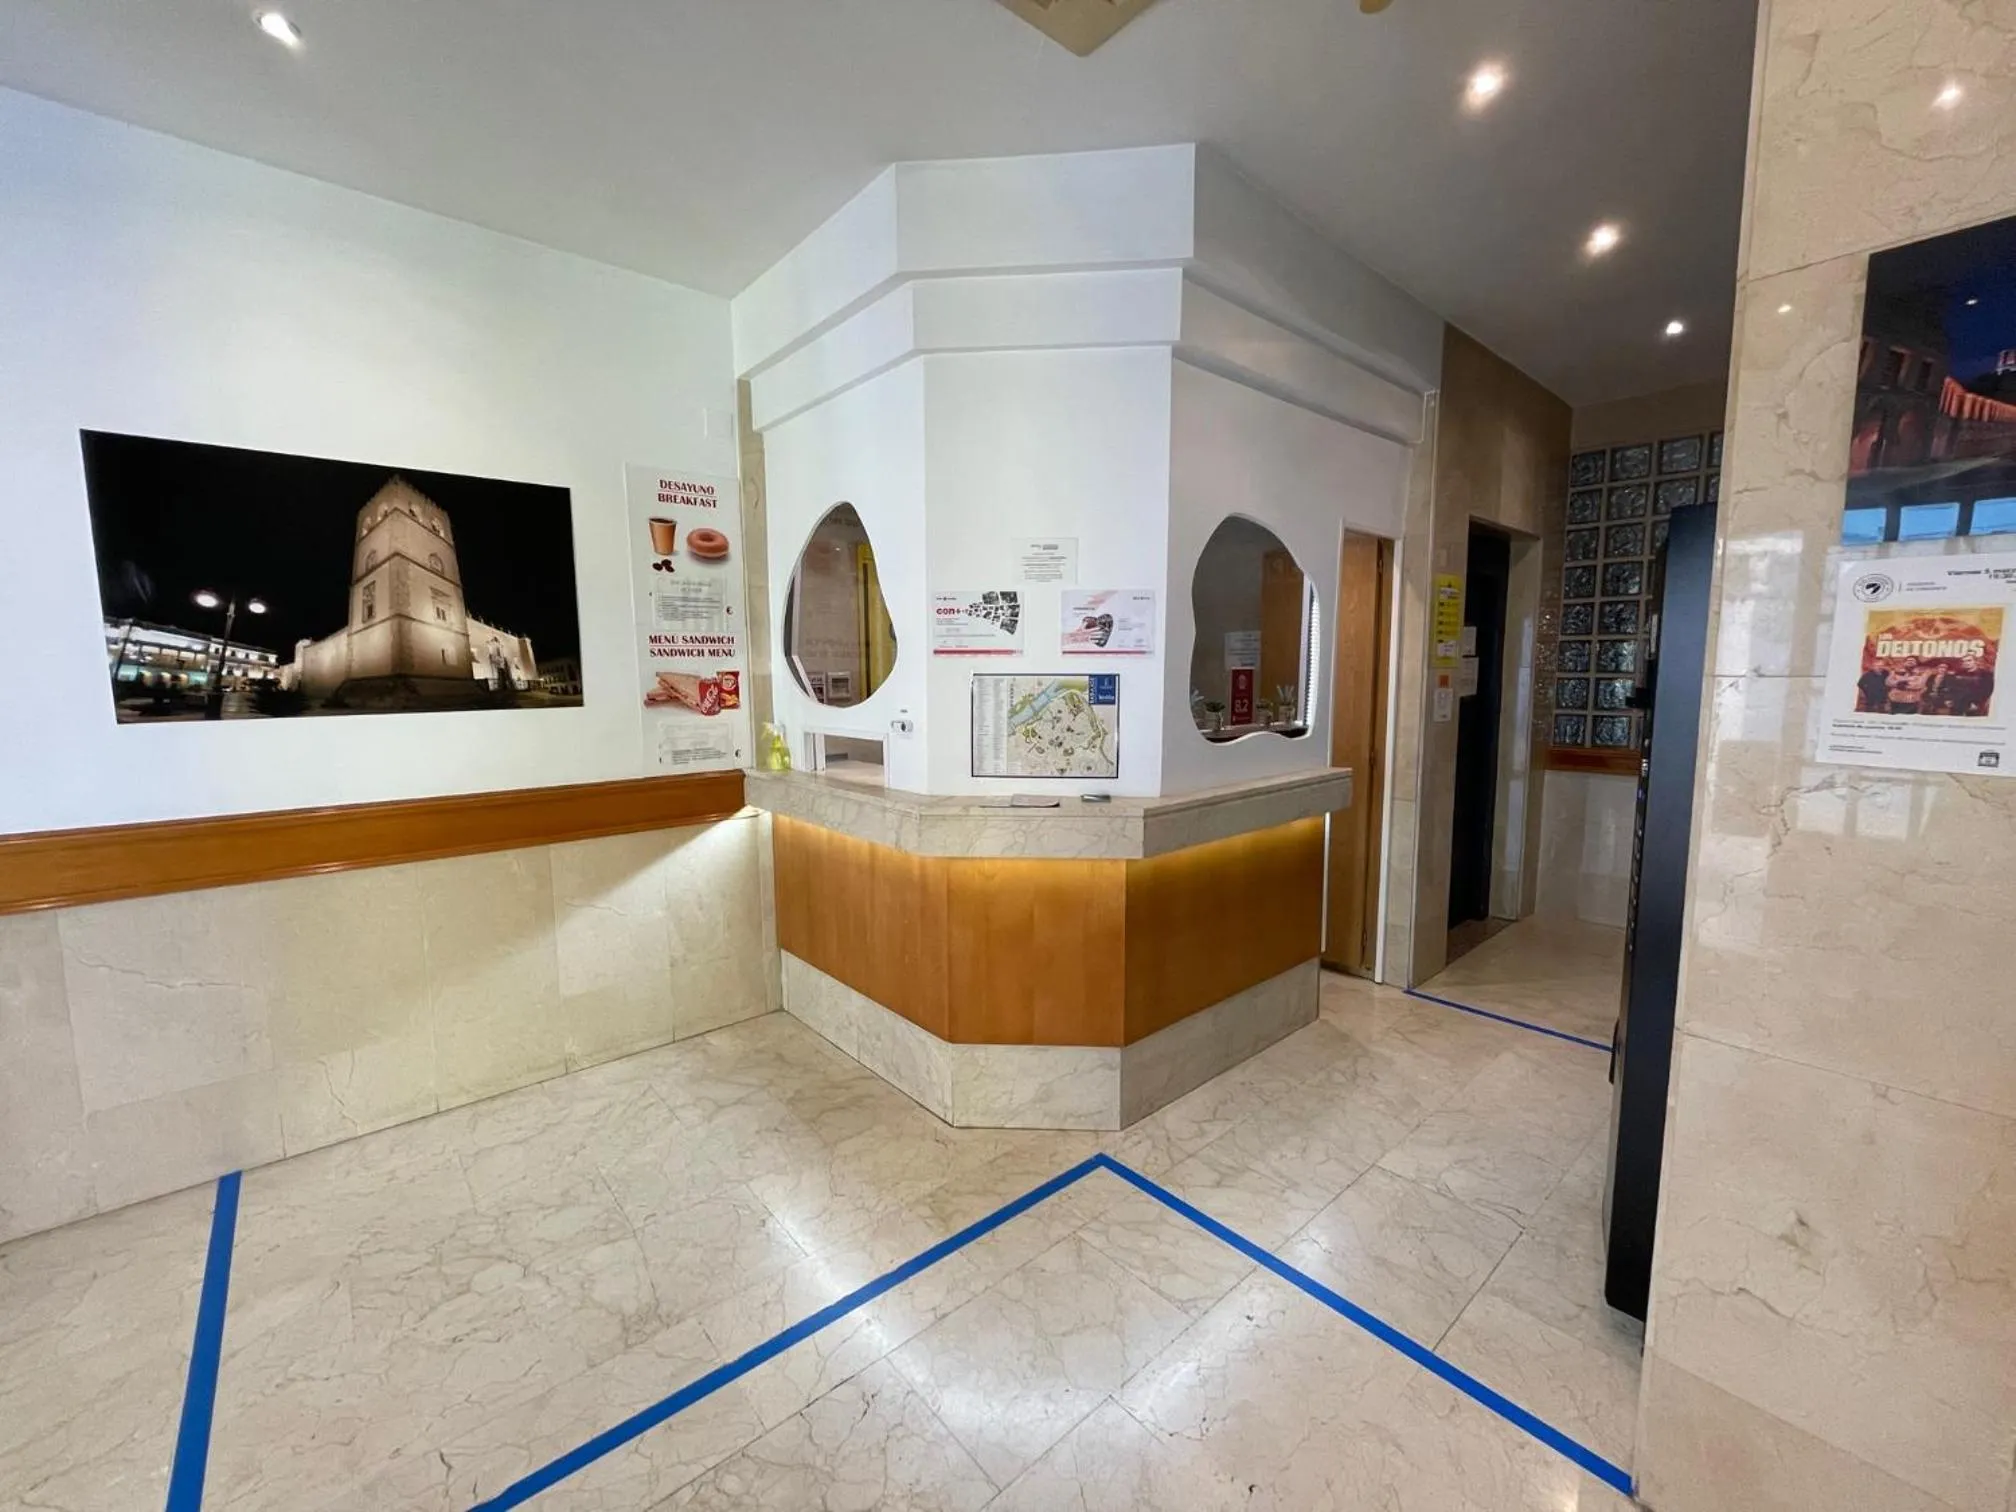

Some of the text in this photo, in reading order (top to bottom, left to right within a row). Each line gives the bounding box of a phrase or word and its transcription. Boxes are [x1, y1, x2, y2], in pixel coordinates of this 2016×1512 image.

[659, 479, 715, 496] DESAYUNO
[657, 492, 718, 509] BREAKFAST
[648, 634, 735, 645] MENU SANDWICH
[649, 647, 736, 658] SANDWICH MENU
